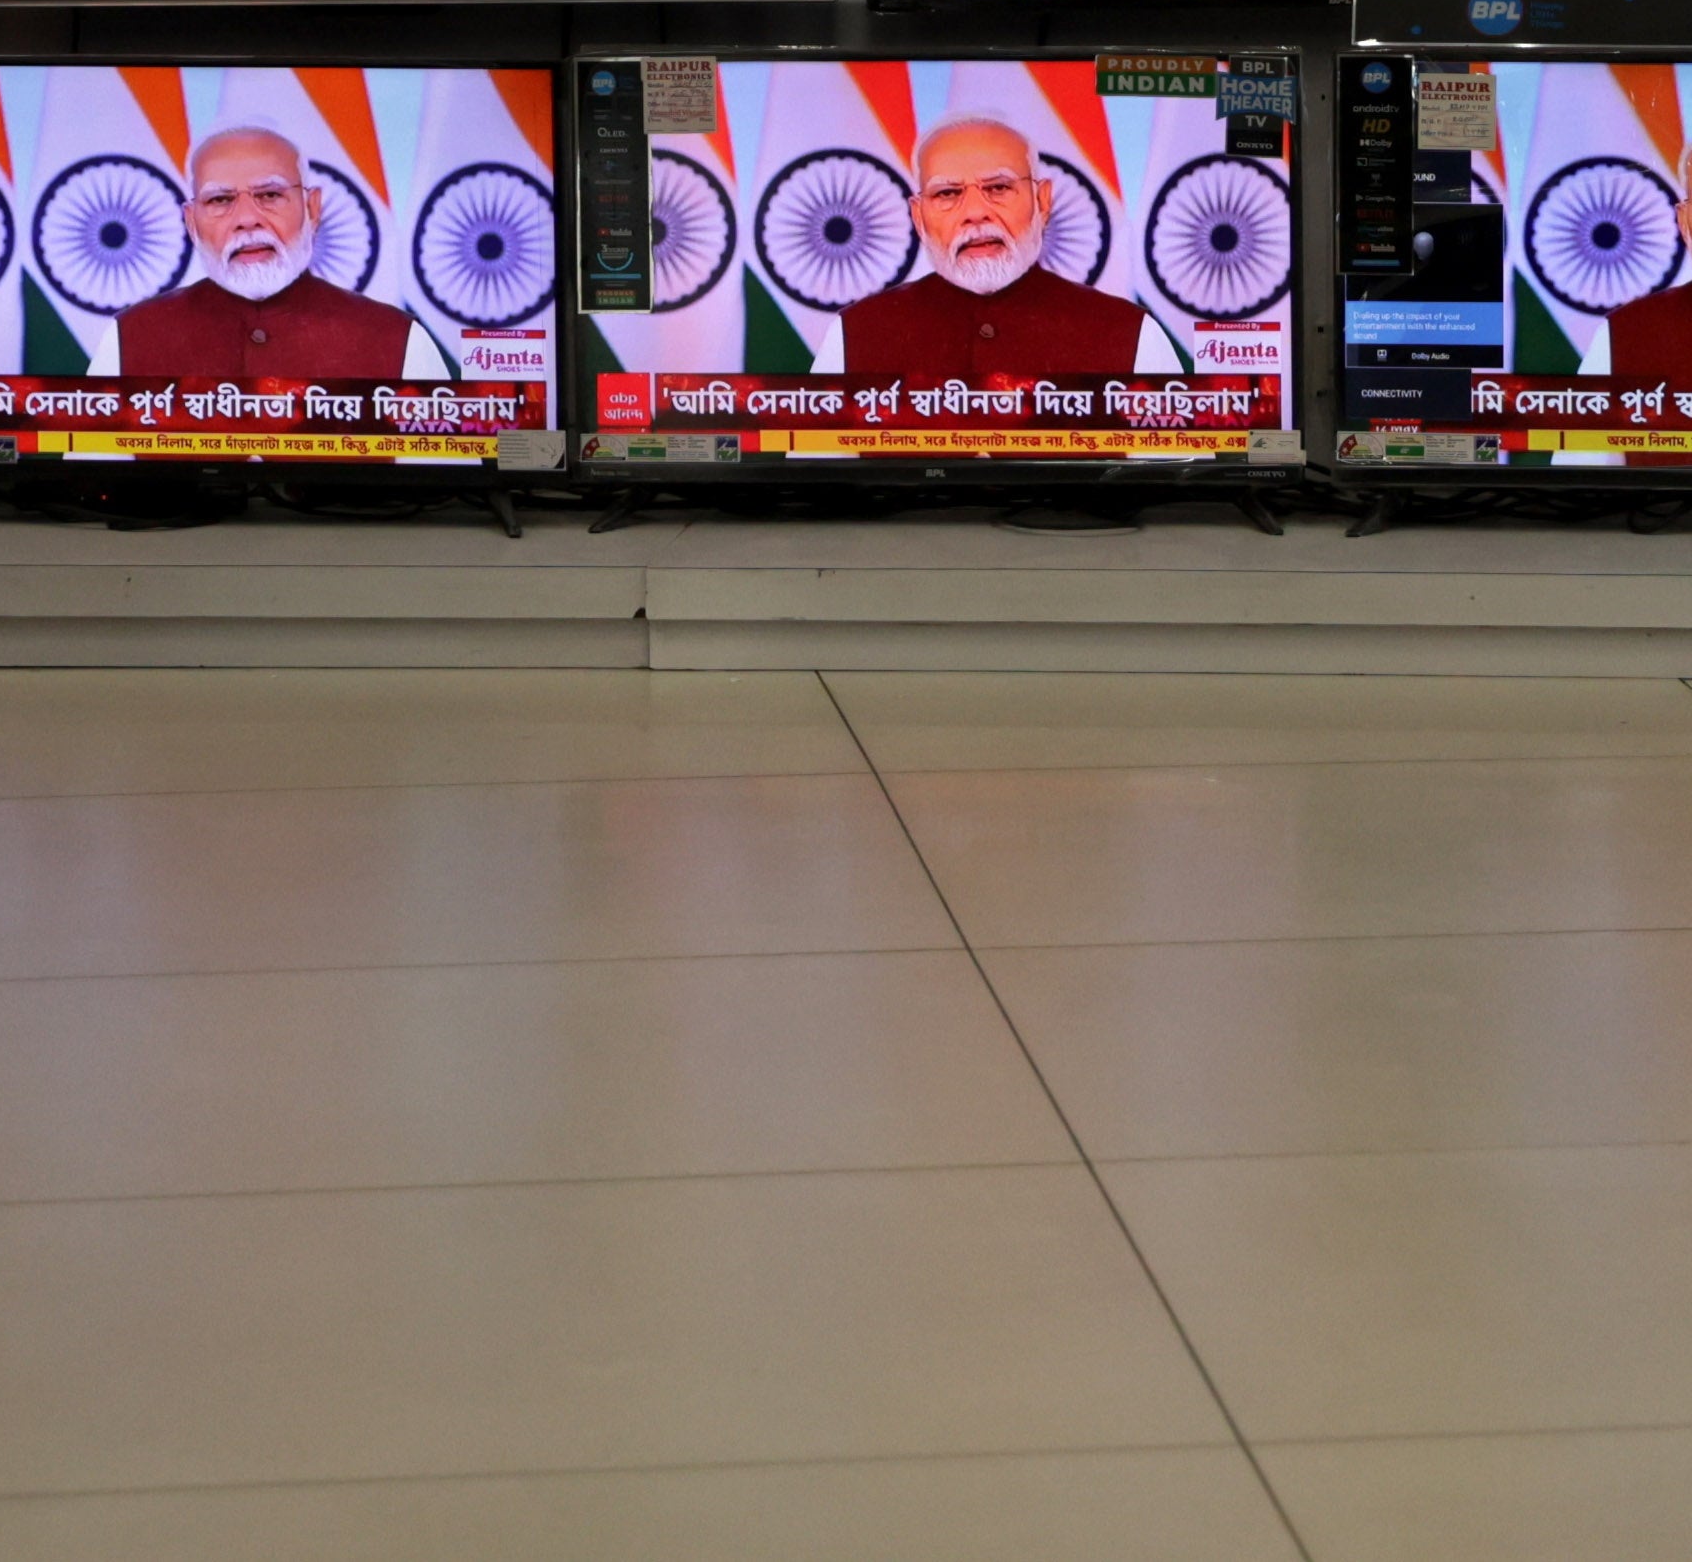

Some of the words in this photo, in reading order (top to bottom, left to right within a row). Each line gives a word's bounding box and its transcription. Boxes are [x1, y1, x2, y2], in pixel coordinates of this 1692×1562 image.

[1470, 0, 1521, 20] BPL
[646, 61, 712, 72] RAIPUR
[1108, 58, 1204, 71] PROUDLY
[1242, 61, 1275, 75] BPL
[592, 79, 615, 88] BPL
[1108, 75, 1205, 93] INDIAN
[1362, 73, 1391, 84] BPL
[1221, 77, 1293, 96] HOME
[1421, 81, 1490, 93] RAIPUR
[1421, 93, 1491, 101] ELECTRONICS
[1221, 95, 1293, 116] THEATER
[1245, 115, 1267, 128] TV
[1362, 118, 1391, 134] HD
[1236, 141, 1273, 150] ONKYO
[1370, 139, 1393, 149] Dolby
[1439, 322, 1476, 331] enhanced
[463, 345, 544, 371] Ajanta
[1196, 339, 1279, 364] Ajanta
[1411, 352, 1431, 361] Dolby
[1431, 352, 1450, 360] Audio
[608, 392, 638, 406] abp
[1361, 388, 1423, 399] CONNECTIVITY
[24, 387, 120, 416] সেনাকে
[129, 383, 175, 425] পূর্ণ
[183, 382, 296, 421] স্বাধীনতা
[304, 385, 362, 421] দিয়ে
[372, 385, 525, 424] দিয়েছিলাম'
[663, 380, 737, 415] 'আমি
[746, 387, 843, 415] সেনাকে
[853, 379, 901, 423] পূর্ণ
[909, 378, 1024, 418] স্বাধীনতা
[1034, 380, 1094, 418] দিয়ে
[1103, 380, 1260, 419] দিয়েছিলাম'
[1515, 387, 1610, 415] সেনাকে
[1620, 382, 1665, 423] পূর্ণ
[925, 468, 946, 478] BPL
[1247, 470, 1287, 479] ONKYO
